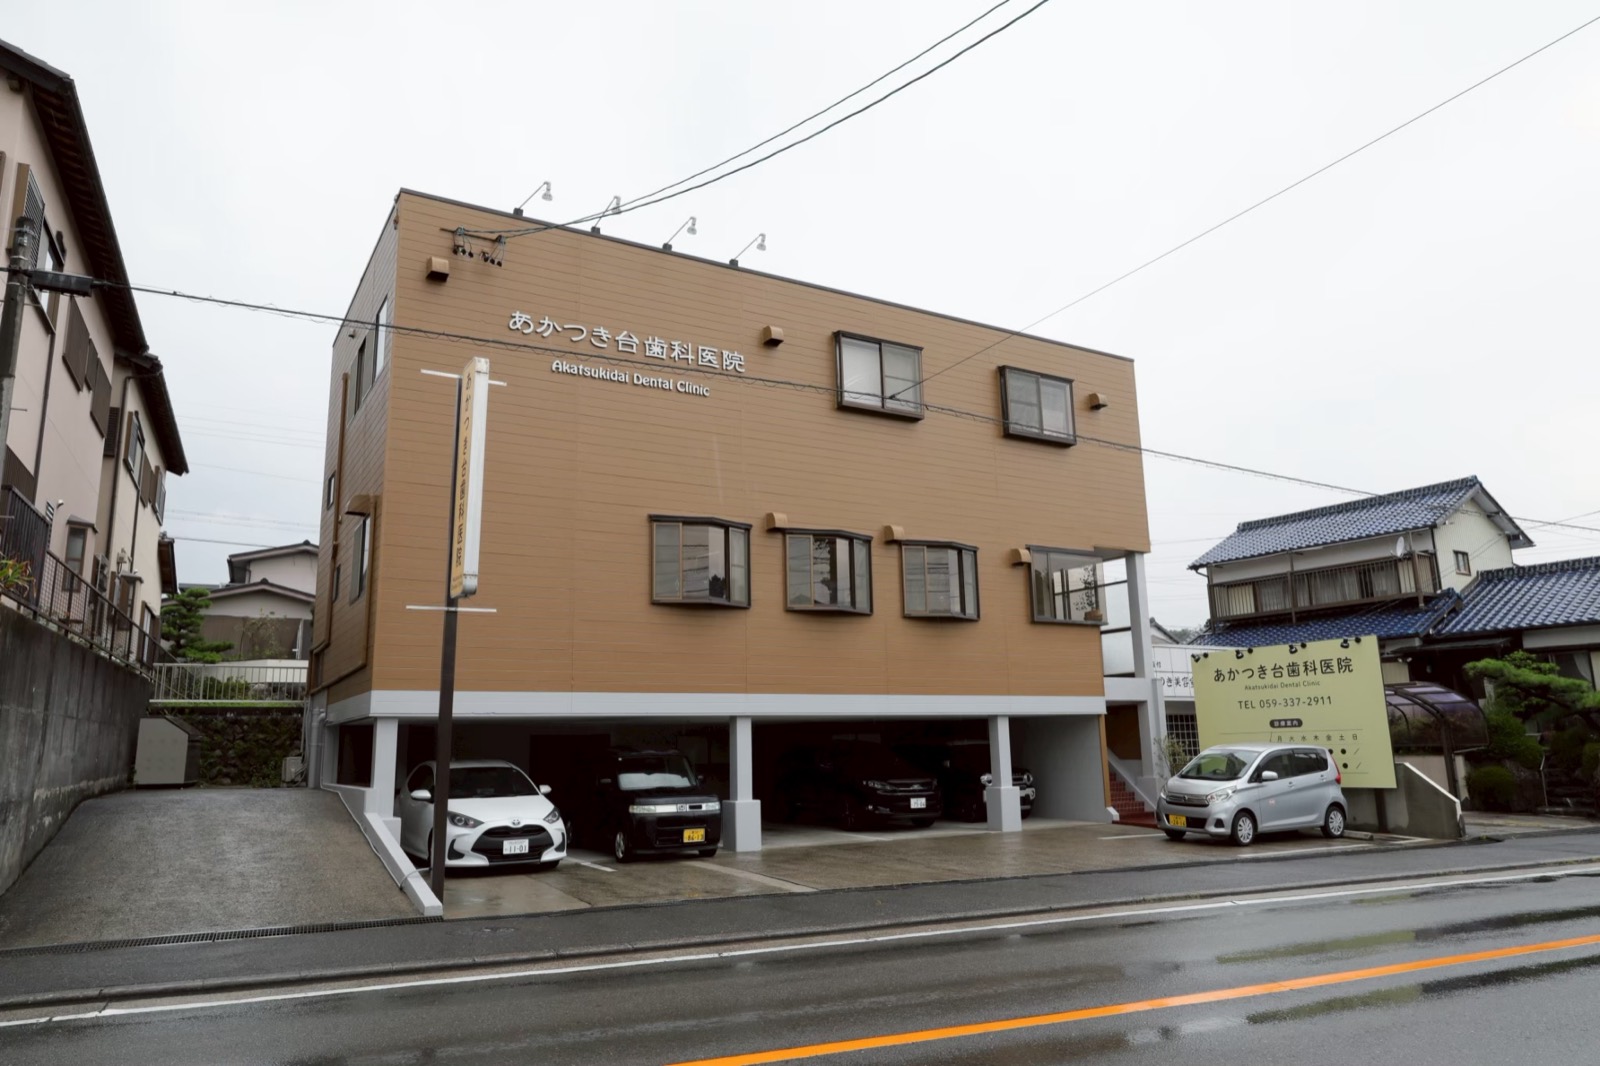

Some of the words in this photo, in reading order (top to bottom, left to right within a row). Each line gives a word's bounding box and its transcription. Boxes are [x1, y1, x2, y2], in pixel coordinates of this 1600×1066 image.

[508, 310, 745, 373] あかつき台歯科医院
[552, 360, 629, 384] Akatsukidai
[633, 372, 673, 391] Dental
[676, 380, 710, 397] Clinic
[1213, 656, 1354, 683] あかつき台歯科医院
[1244, 683, 1279, 691] Akatsukidai
[1280, 681, 1301, 689] Dental
[1238, 700, 1256, 710] TEL
[1259, 696, 1332, 709] 059-337-2911
